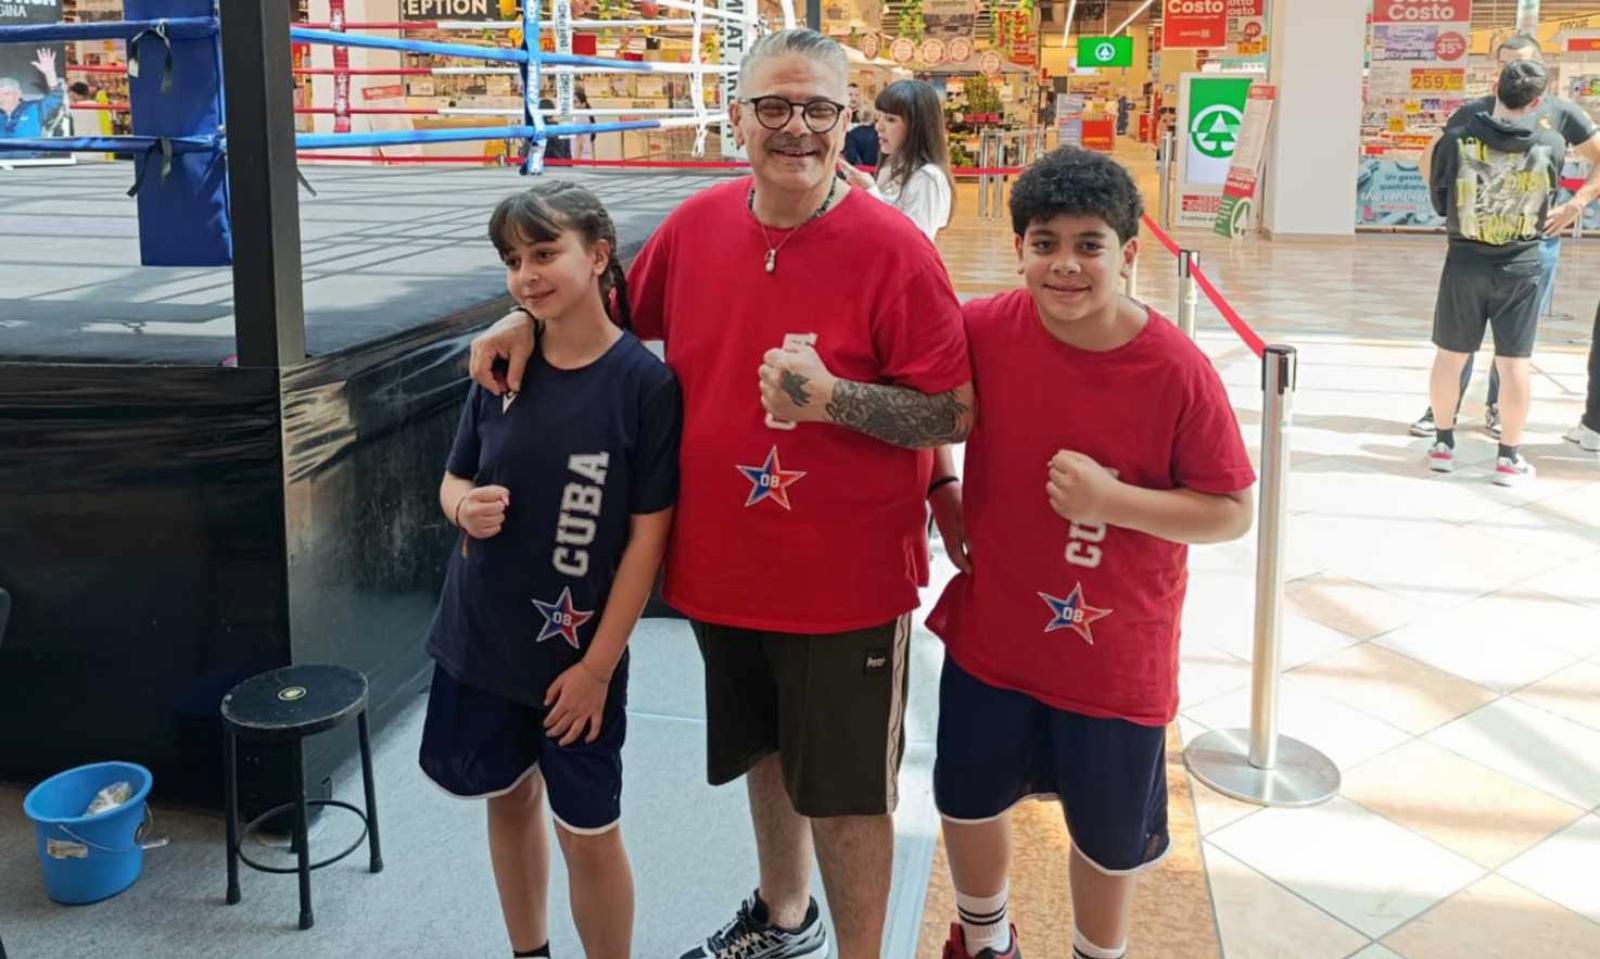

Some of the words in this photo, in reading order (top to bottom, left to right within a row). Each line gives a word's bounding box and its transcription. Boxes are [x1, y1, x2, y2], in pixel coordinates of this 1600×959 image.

[403, 0, 488, 15] EPTION
[1167, 0, 1224, 14] Costo
[1227, 7, 1255, 15] osto
[1388, 4, 1455, 20] Costo
[759, 473, 781, 488] 08
[553, 451, 610, 577] CUBA
[551, 610, 573, 626] 08
[1062, 606, 1084, 623] 08
